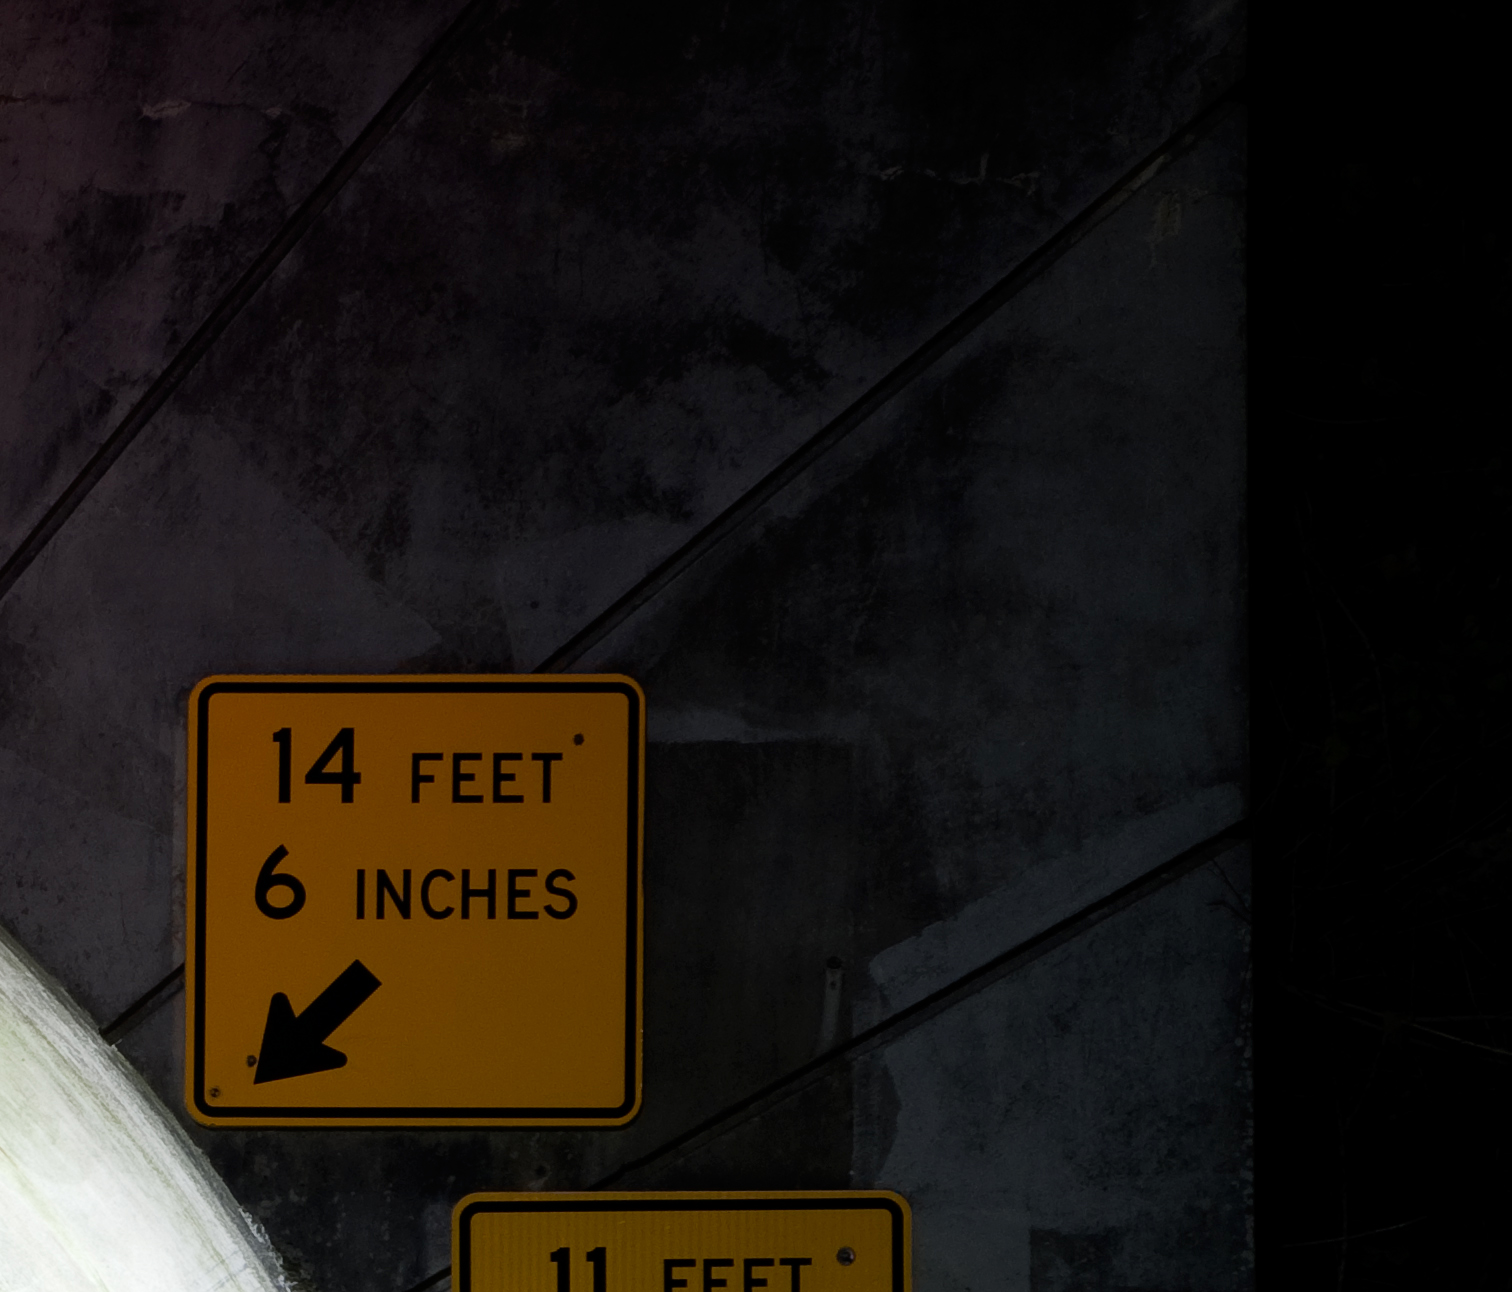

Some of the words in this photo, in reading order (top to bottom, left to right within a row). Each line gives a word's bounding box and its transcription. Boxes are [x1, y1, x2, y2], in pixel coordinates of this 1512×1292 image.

[272, 727, 362, 804] 14
[410, 752, 564, 804] FEET
[254, 844, 307, 920] 6
[356, 868, 579, 920] INCHES
